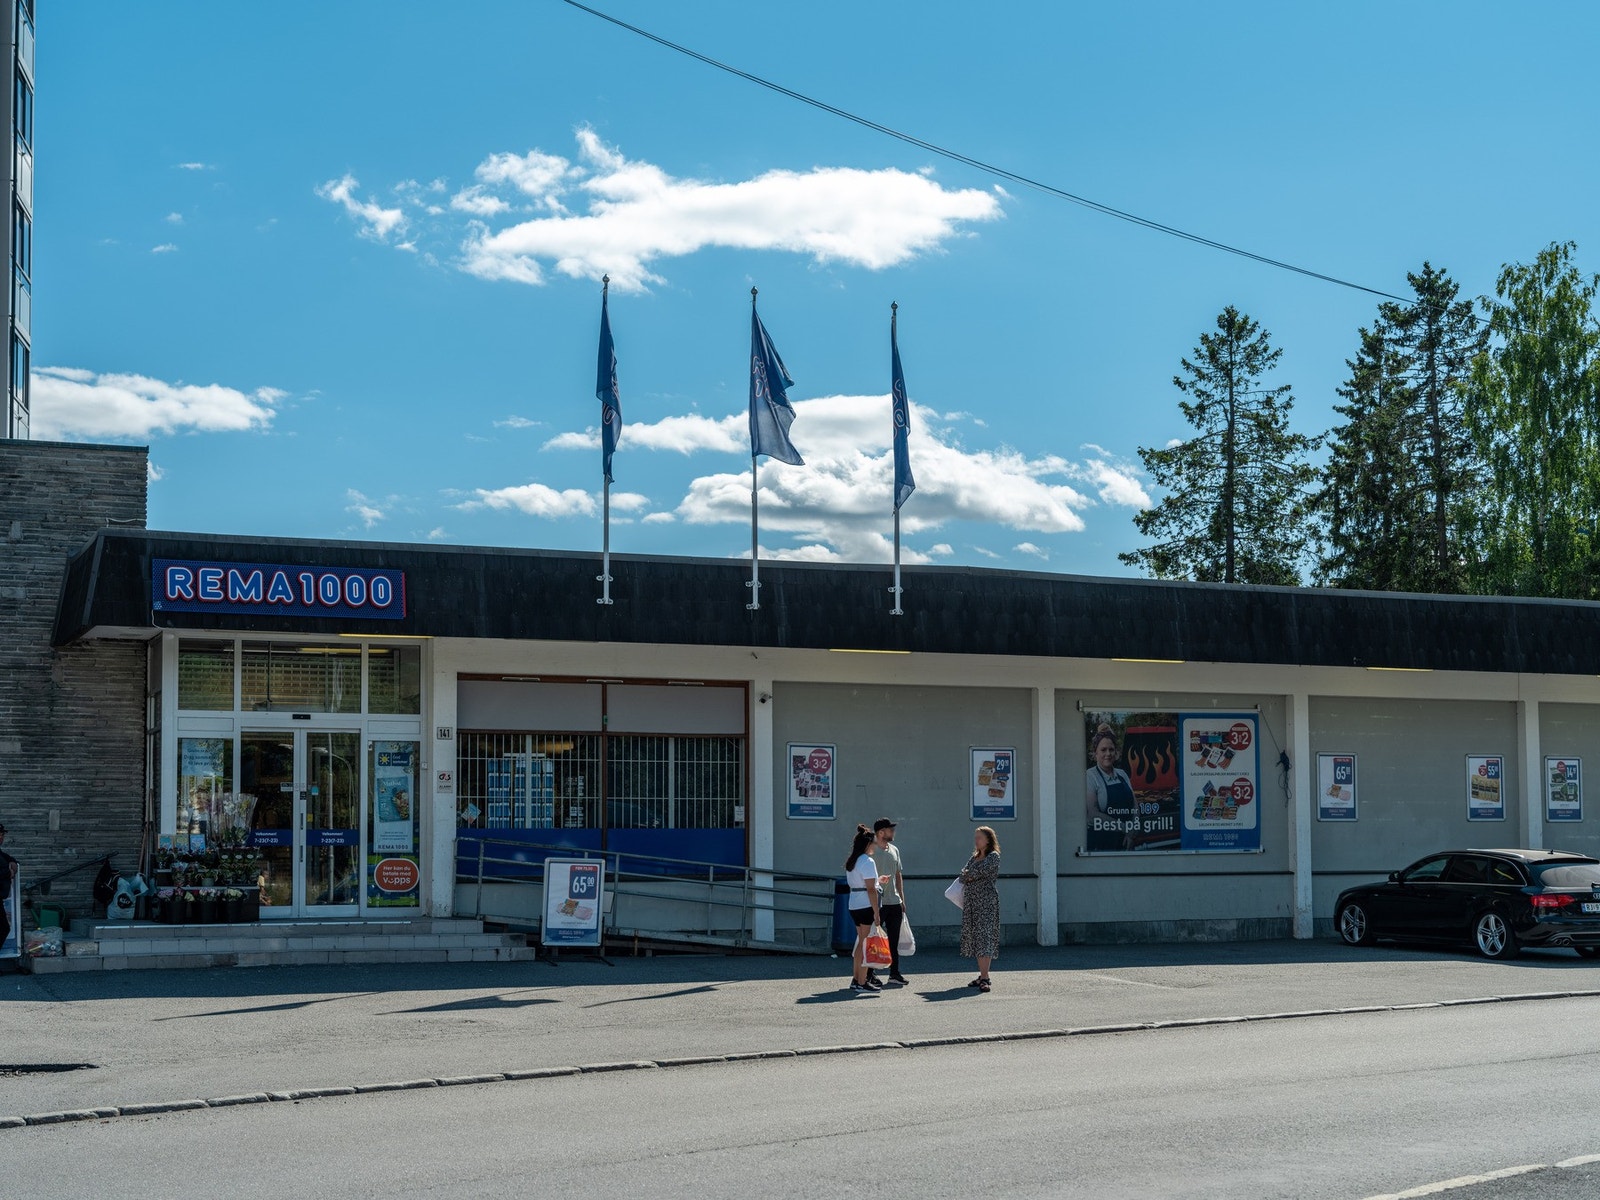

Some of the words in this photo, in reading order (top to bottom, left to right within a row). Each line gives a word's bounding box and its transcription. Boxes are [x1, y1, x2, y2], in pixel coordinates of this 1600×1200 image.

[166, 567, 294, 605] REMA
[299, 573, 393, 608] 1000
[439, 729, 450, 738] 141
[1231, 732, 1238, 745] 3
[1242, 732, 1249, 745] 2
[813, 759, 819, 769] 3
[821, 759, 828, 769] 2
[1233, 786, 1241, 799] 3
[1243, 786, 1251, 799] 2
[1107, 806, 1129, 815] Grunn
[1138, 802, 1159, 815] 189
[1093, 817, 1122, 831] Best
[1125, 816, 1141, 833] på
[1143, 816, 1173, 833] grill!
